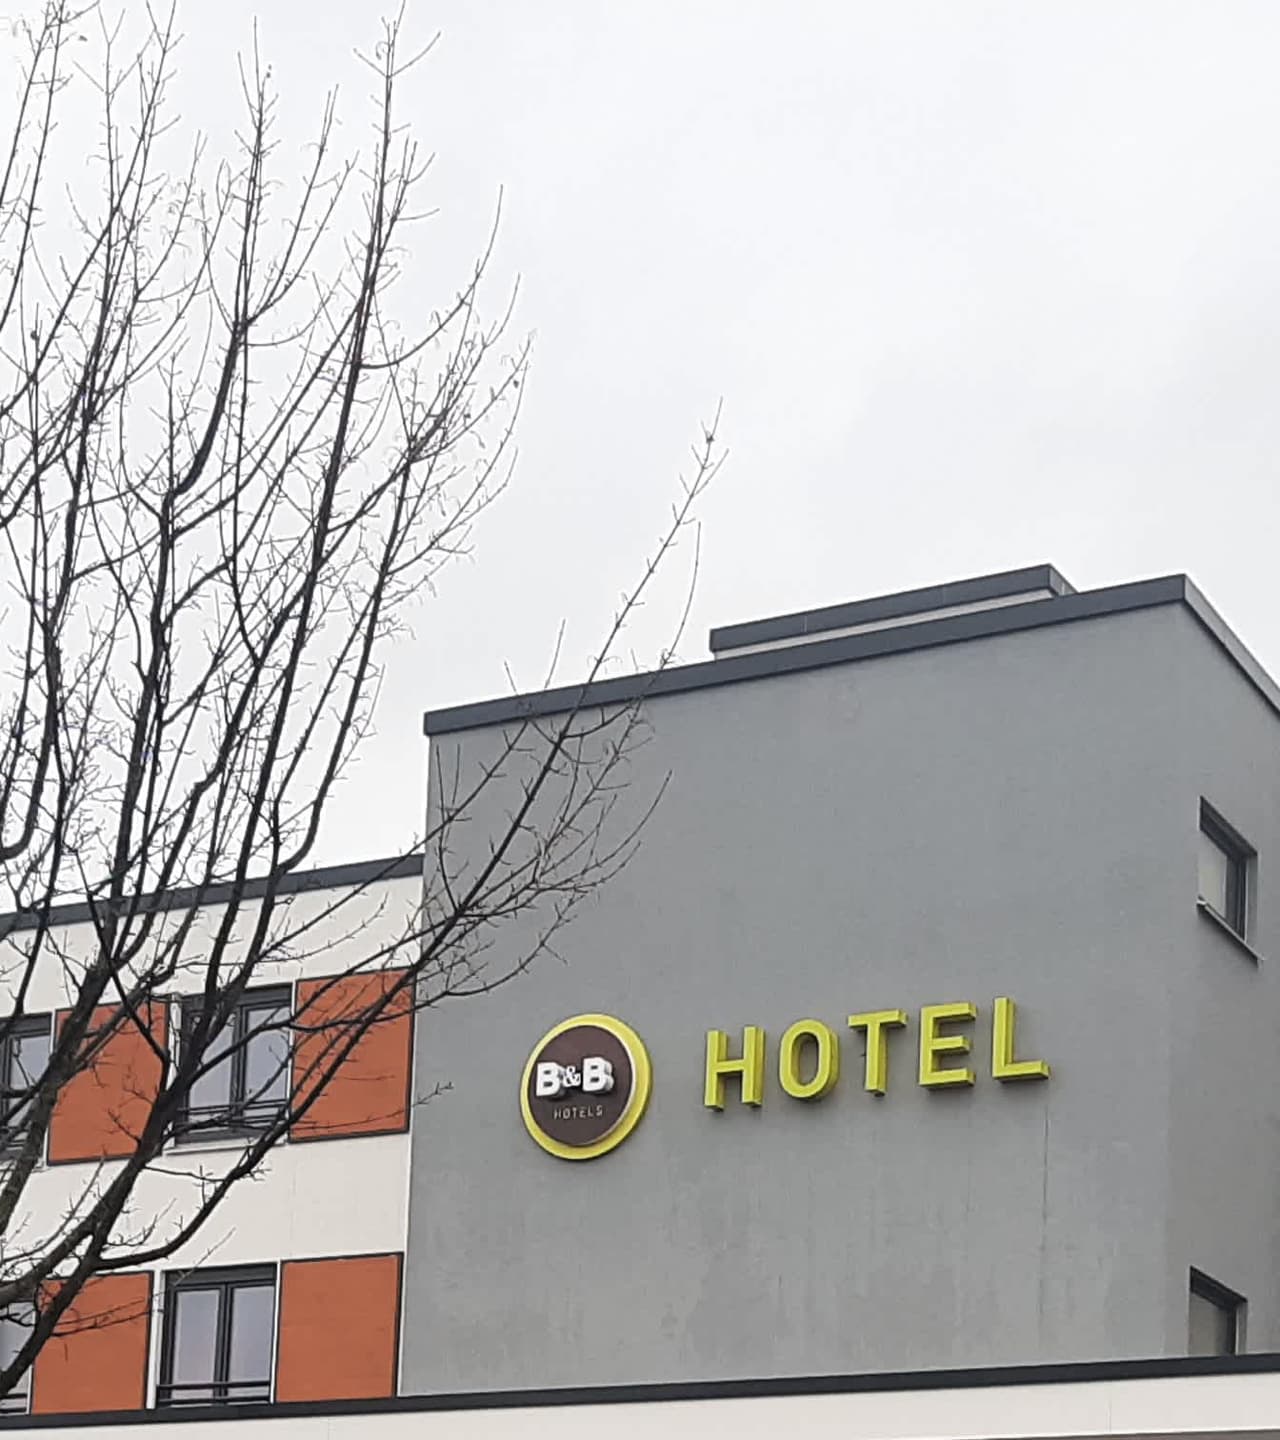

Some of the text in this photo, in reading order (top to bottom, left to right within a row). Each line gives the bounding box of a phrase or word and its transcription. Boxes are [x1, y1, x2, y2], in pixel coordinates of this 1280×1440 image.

[703, 997, 1050, 1110] HOTEL
[536, 1057, 614, 1097] B&B
[553, 1105, 603, 1120] HOTELS
